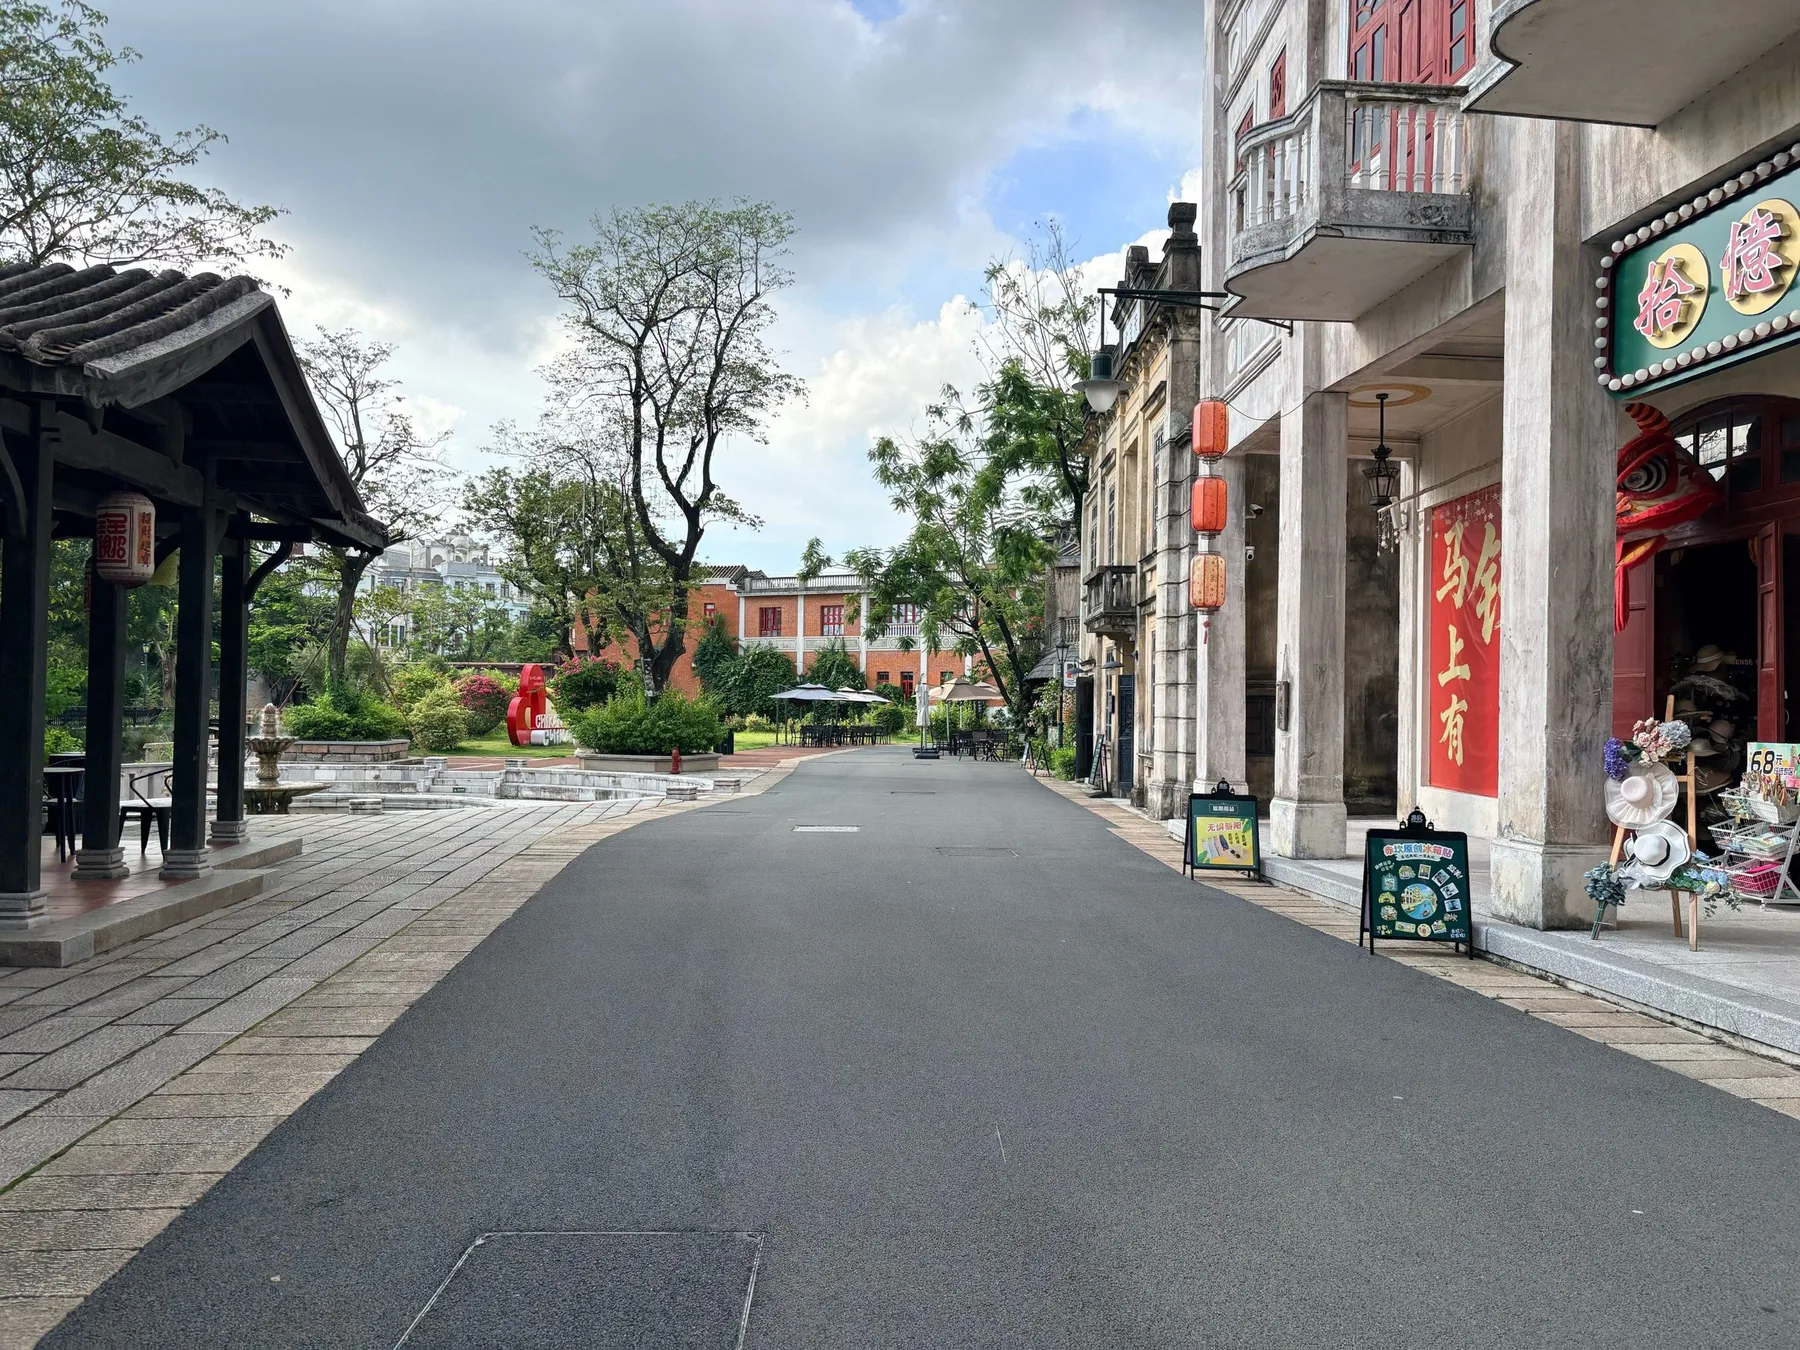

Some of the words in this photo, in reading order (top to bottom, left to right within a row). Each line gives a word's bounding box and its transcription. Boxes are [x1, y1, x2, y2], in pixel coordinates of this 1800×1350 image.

[1436, 519, 1471, 767] 马上有
[1383, 843, 1454, 858] 赤坎原创冰箱贴
